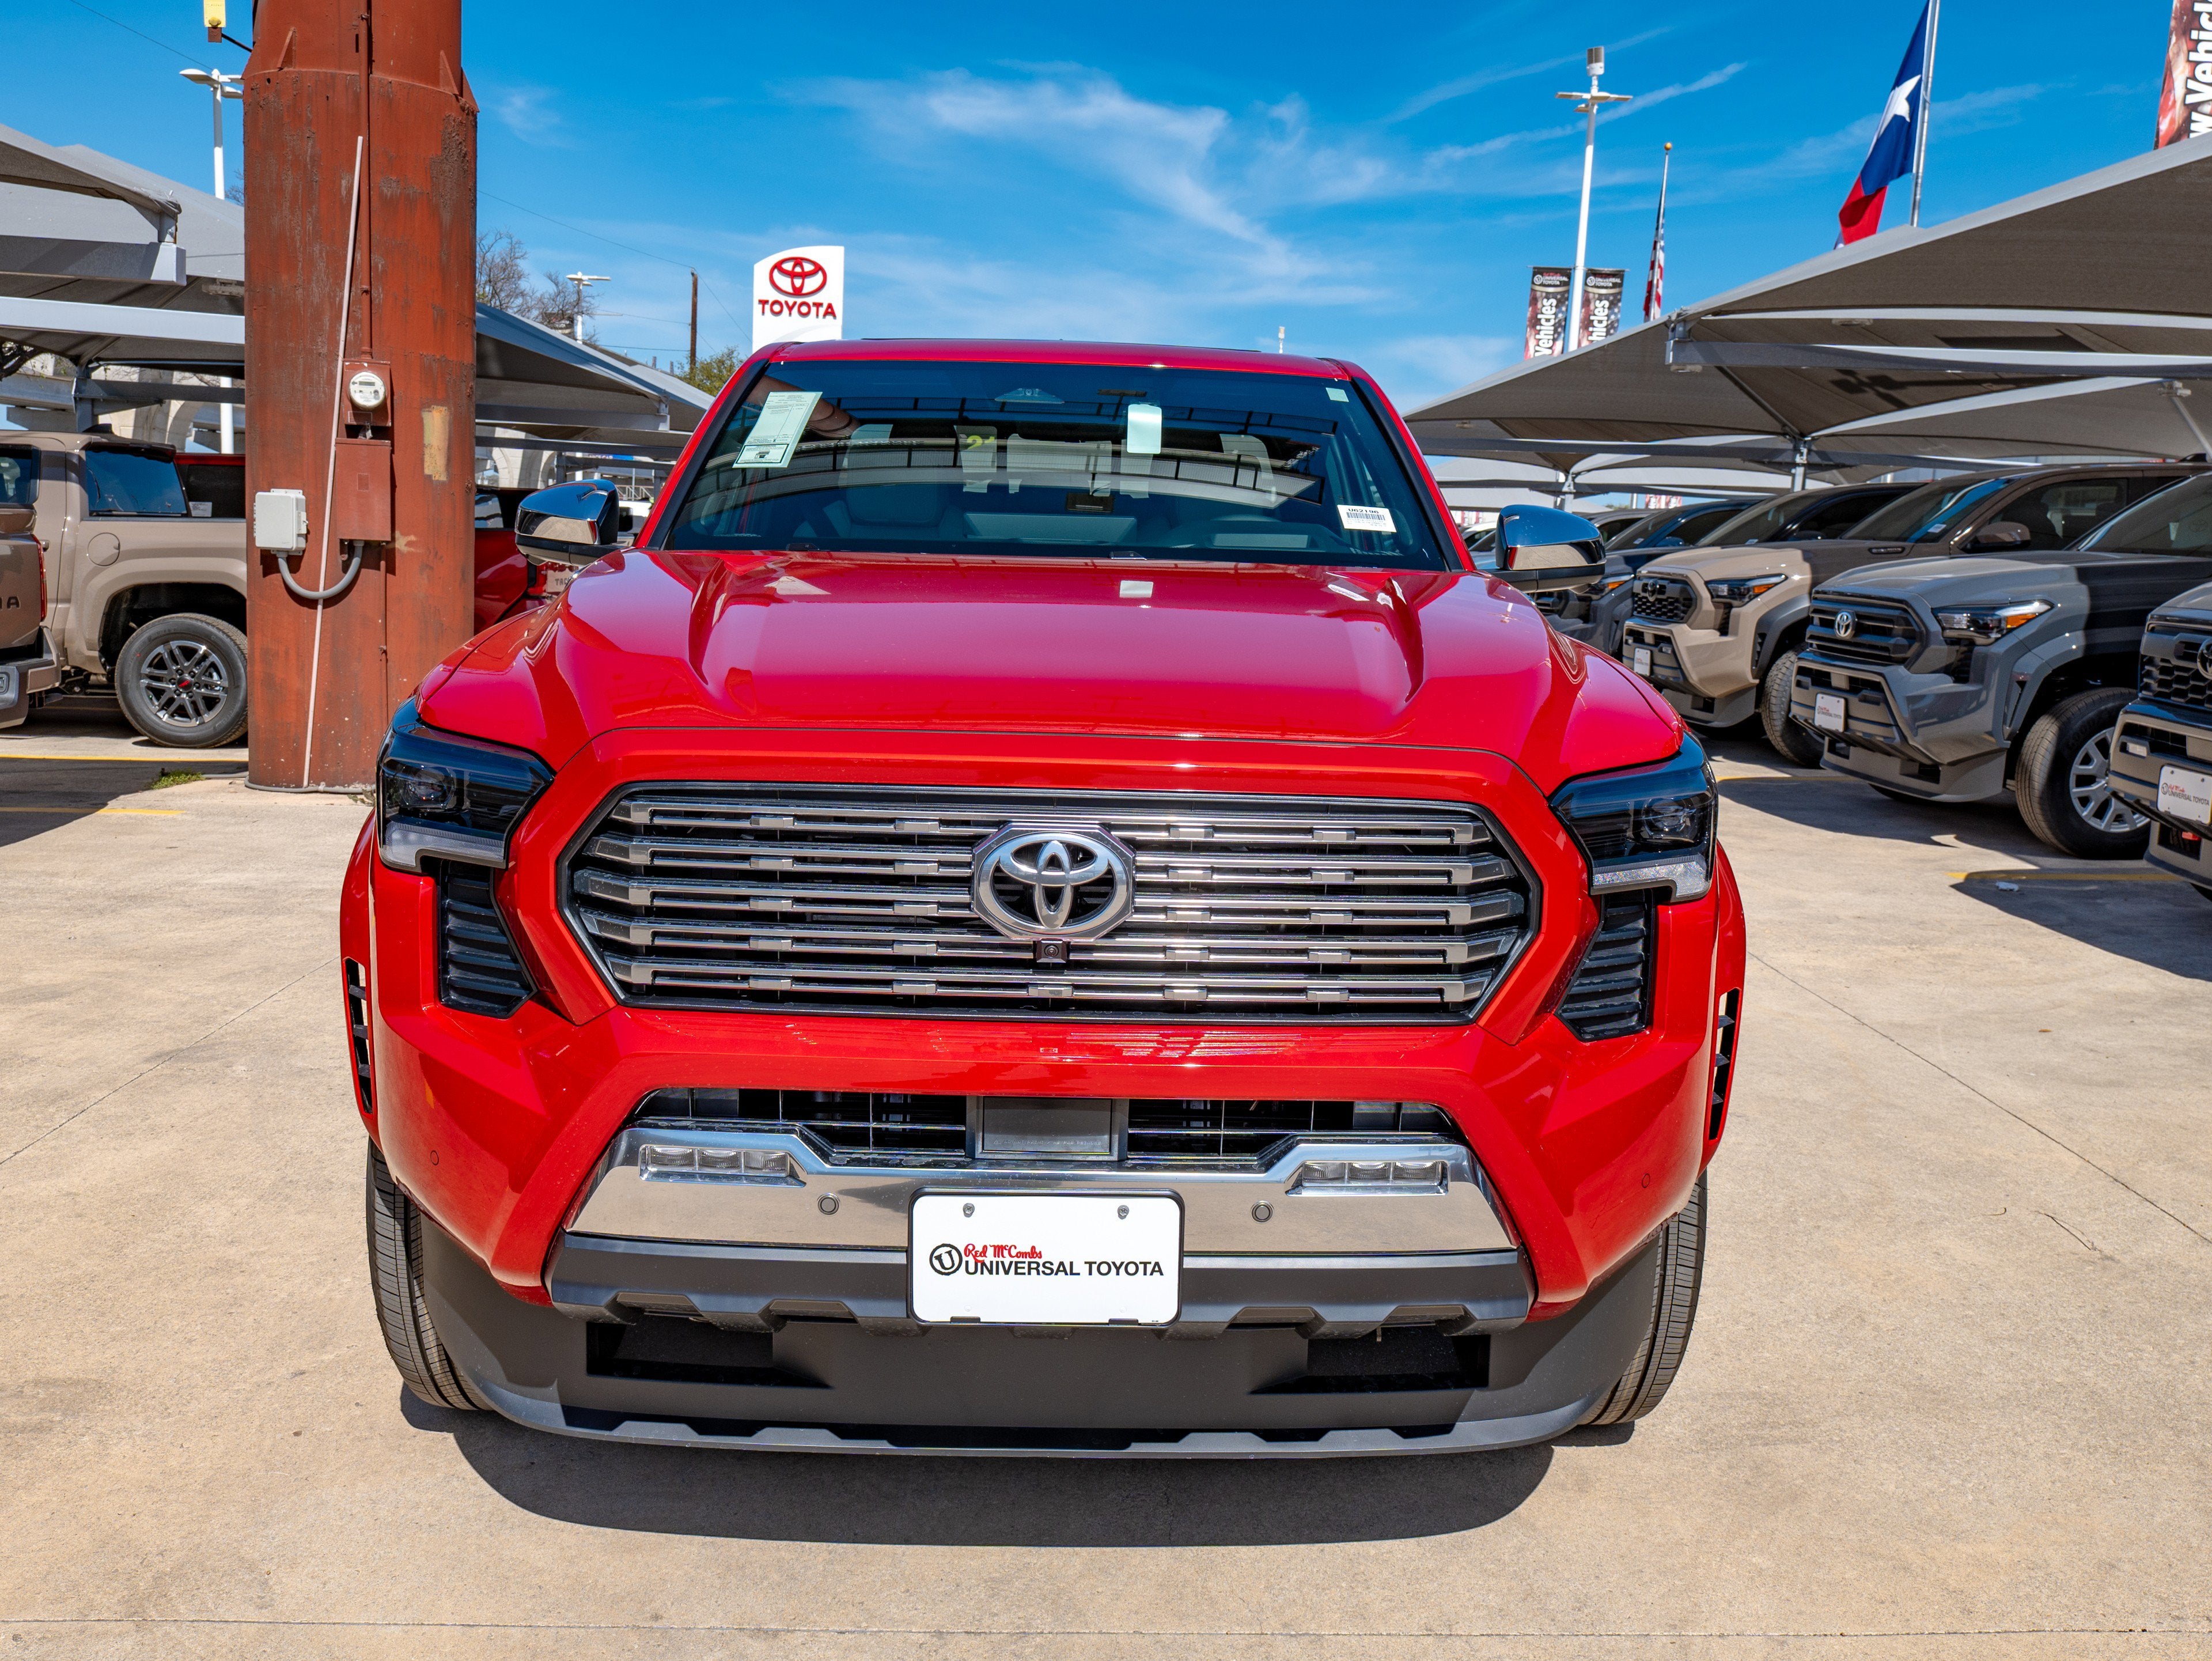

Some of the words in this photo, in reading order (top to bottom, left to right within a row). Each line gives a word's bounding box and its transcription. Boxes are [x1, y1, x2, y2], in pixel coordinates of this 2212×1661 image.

[758, 299, 837, 320] TOYOTA
[1588, 300, 1609, 343] hicles
[2168, 790, 2192, 801] UNIVERSAL
[2192, 796, 2210, 805] TOYOTA
[964, 1243, 987, 1264] Red
[990, 1244, 1043, 1259] McCombs
[965, 1260, 1080, 1276] UNIVERSAL
[1084, 1261, 1164, 1276] TOYOTA
